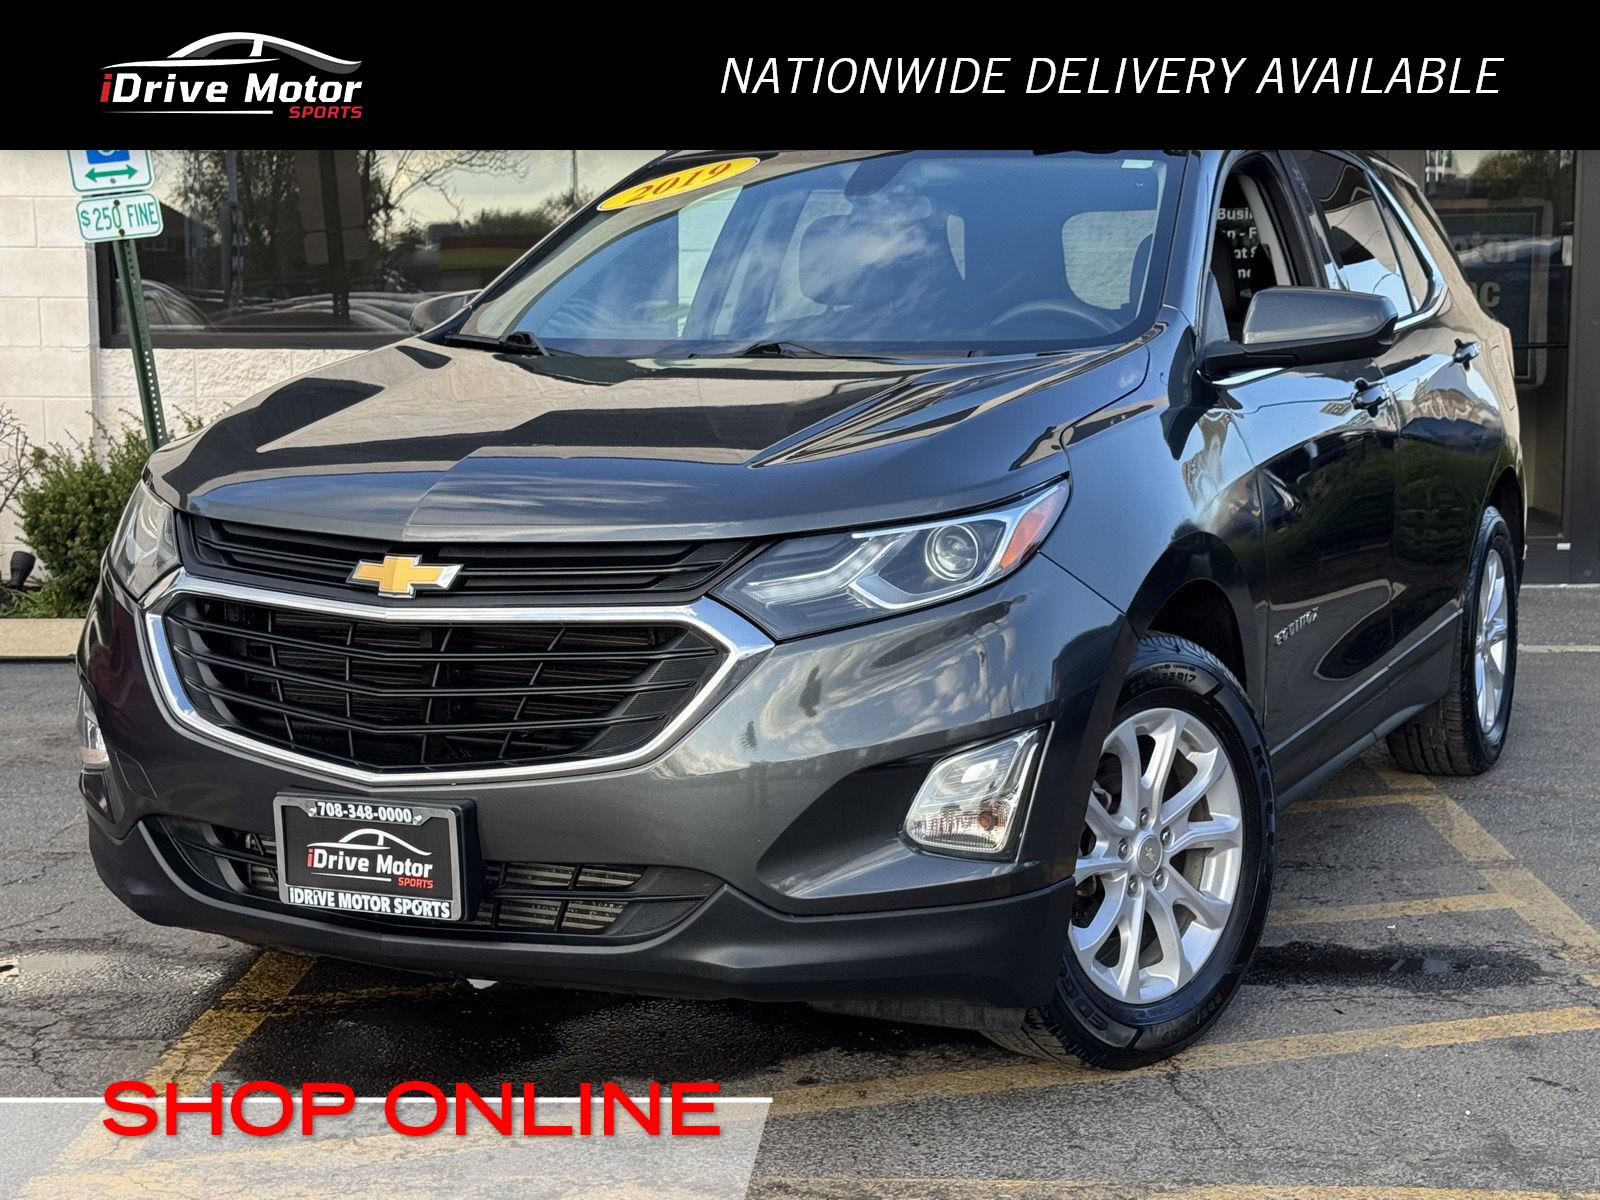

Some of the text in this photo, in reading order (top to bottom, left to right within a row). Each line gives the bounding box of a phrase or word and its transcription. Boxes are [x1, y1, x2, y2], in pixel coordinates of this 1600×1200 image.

[624, 162, 732, 205] 2019
[126, 202, 158, 228] FINE
[318, 802, 412, 823] 708-348-0000
[307, 849, 434, 878] iDrive Motor
[398, 877, 434, 889] SPORTS
[339, 893, 391, 914] MOTOR
[394, 899, 451, 919] SPORTS
